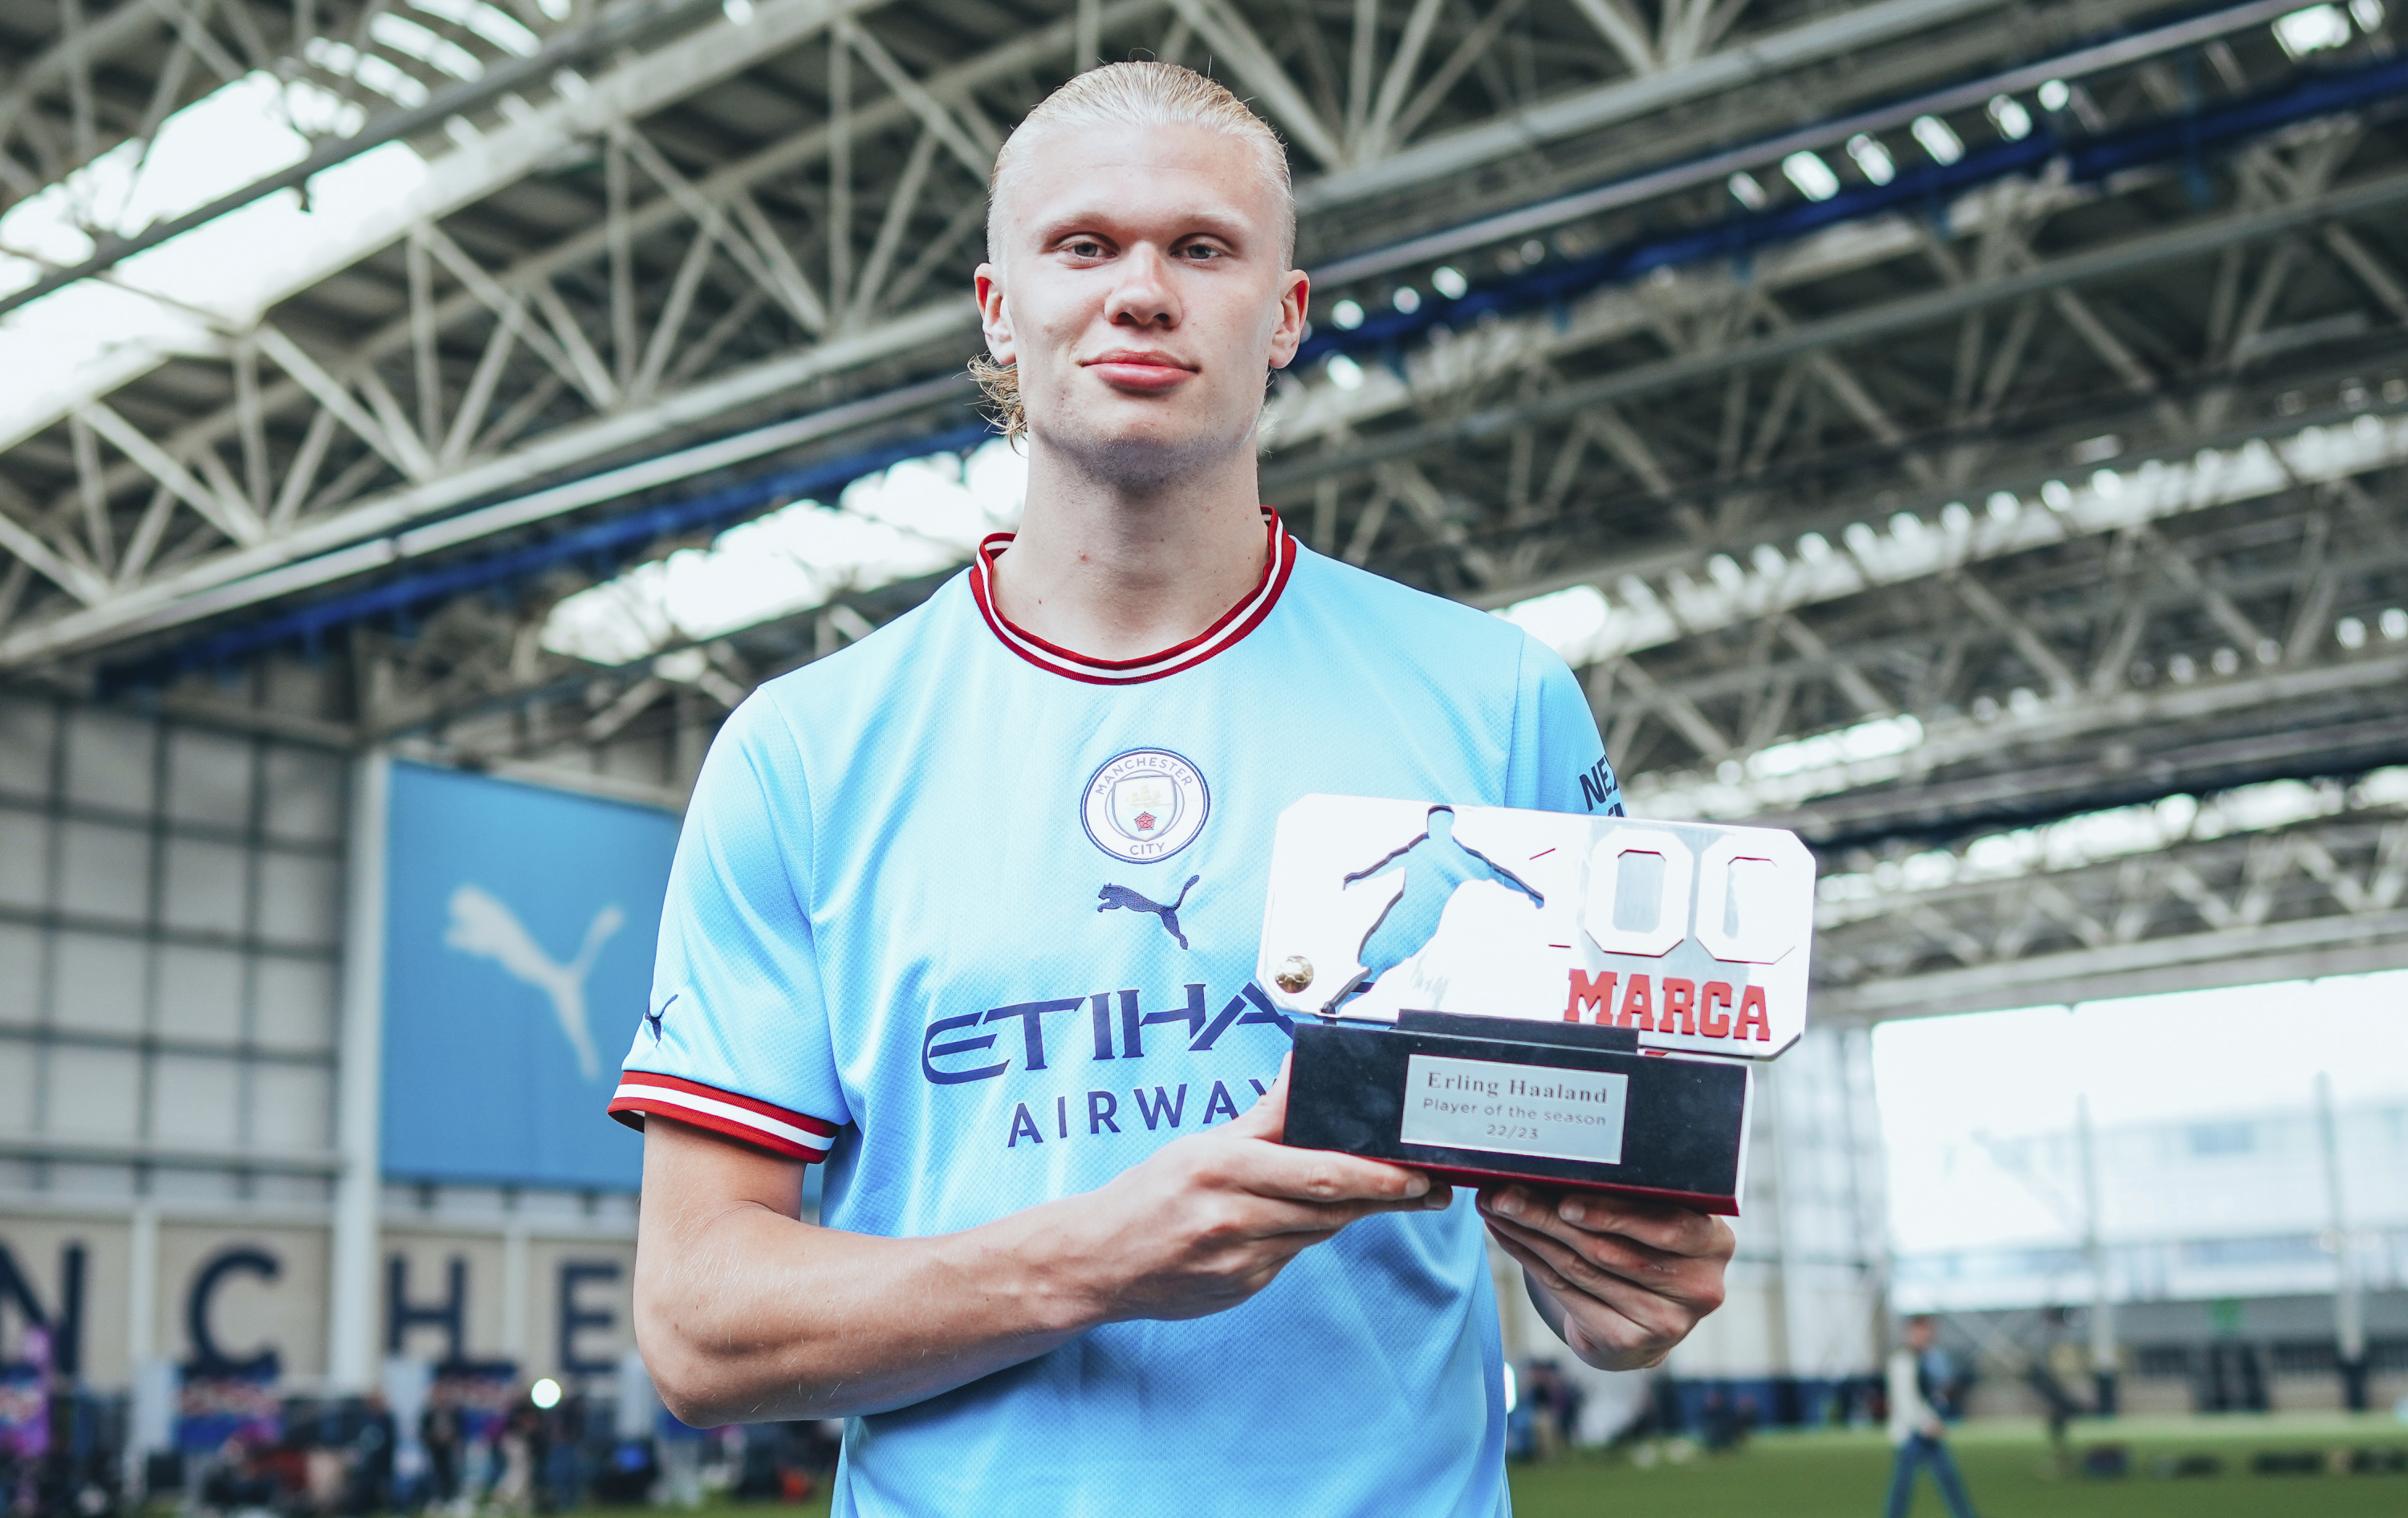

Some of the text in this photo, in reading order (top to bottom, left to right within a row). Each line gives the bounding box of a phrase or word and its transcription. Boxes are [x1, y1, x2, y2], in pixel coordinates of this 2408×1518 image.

[1095, 757, 1193, 795] MANCHESTER
[1129, 842, 1165, 856] CITY
[1564, 968, 1771, 1041] MARCA
[921, 982, 1296, 1085] ETIHA
[1427, 1072, 1608, 1104] Erling Haaland
[1007, 1078, 1278, 1147] AIRWA
[1423, 1097, 1606, 1125] Player of the season
[1487, 1124, 1539, 1140] 22/23
